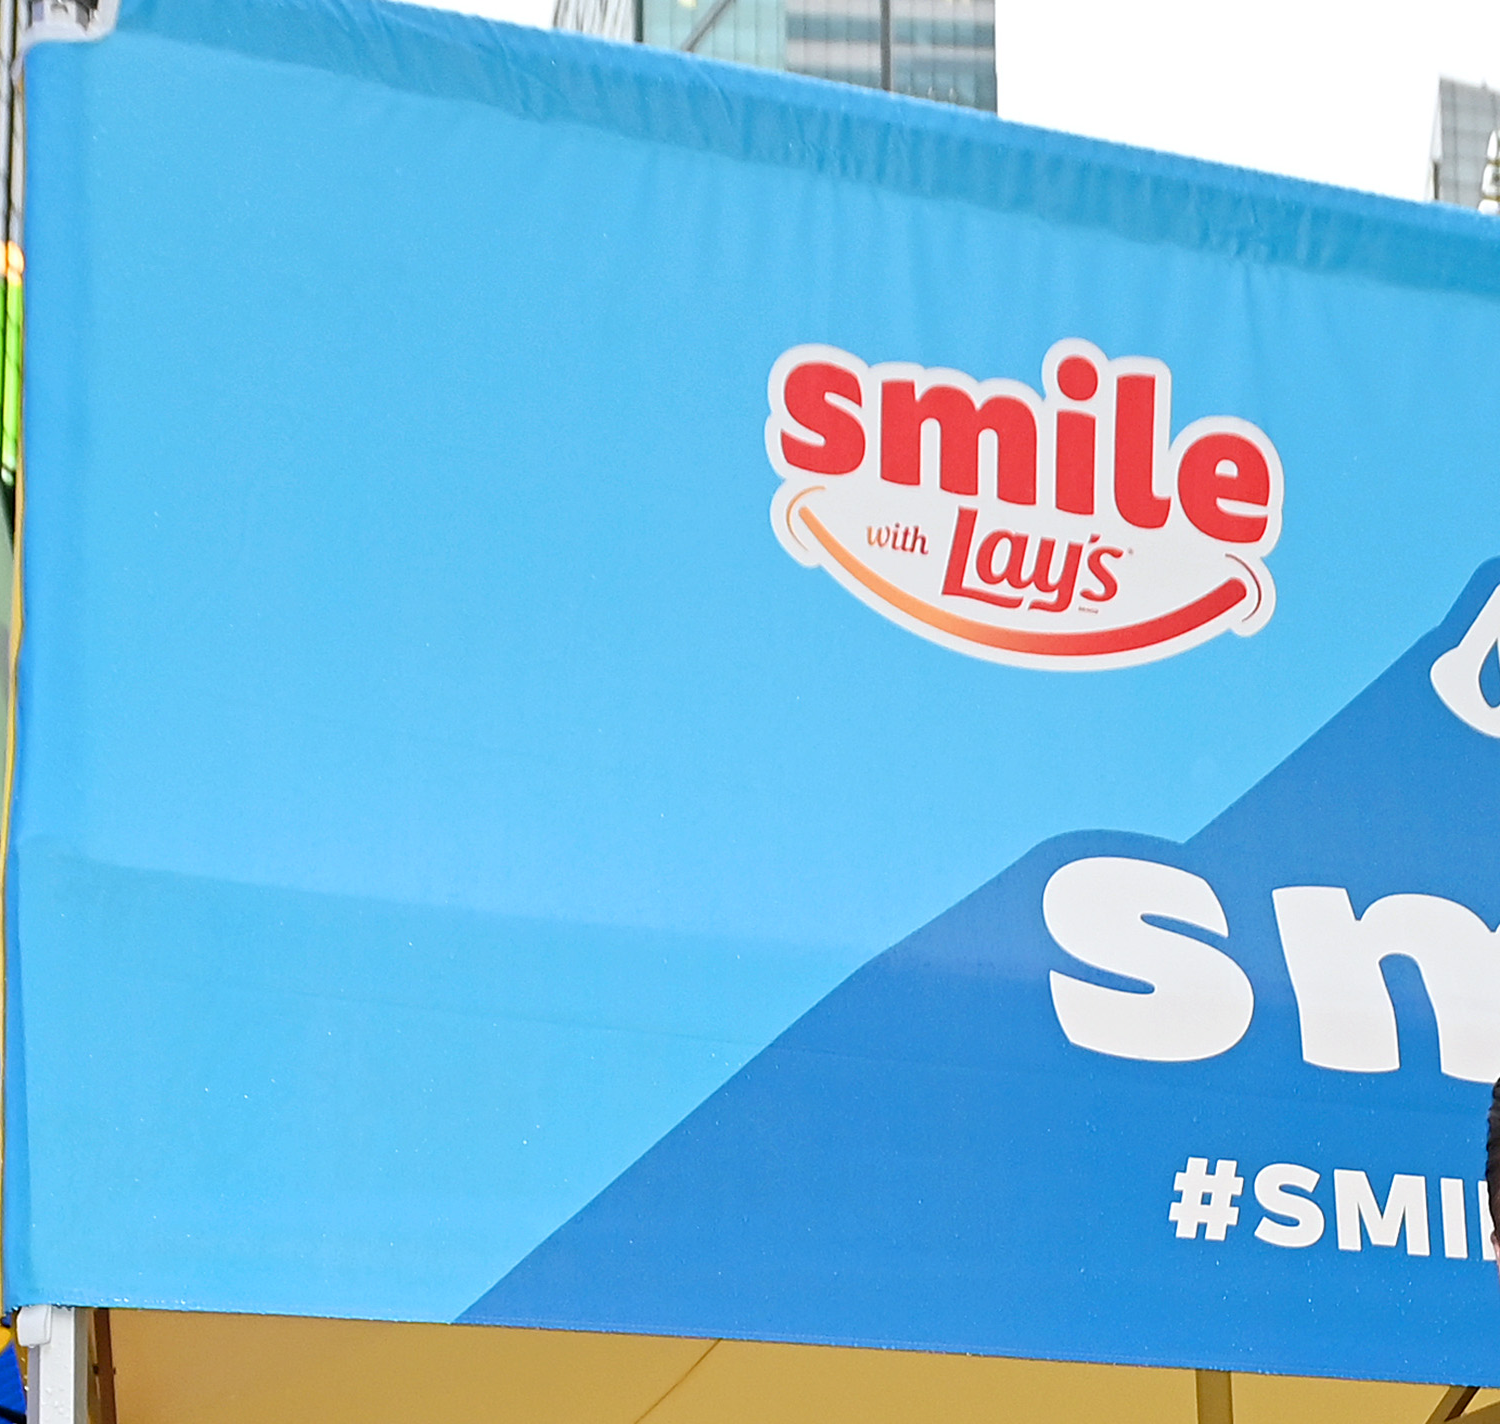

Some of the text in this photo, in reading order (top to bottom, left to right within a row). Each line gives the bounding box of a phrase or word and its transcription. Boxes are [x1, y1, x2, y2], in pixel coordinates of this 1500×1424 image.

[781, 356, 1270, 544] smile
[866, 507, 1126, 612] with Lay's
